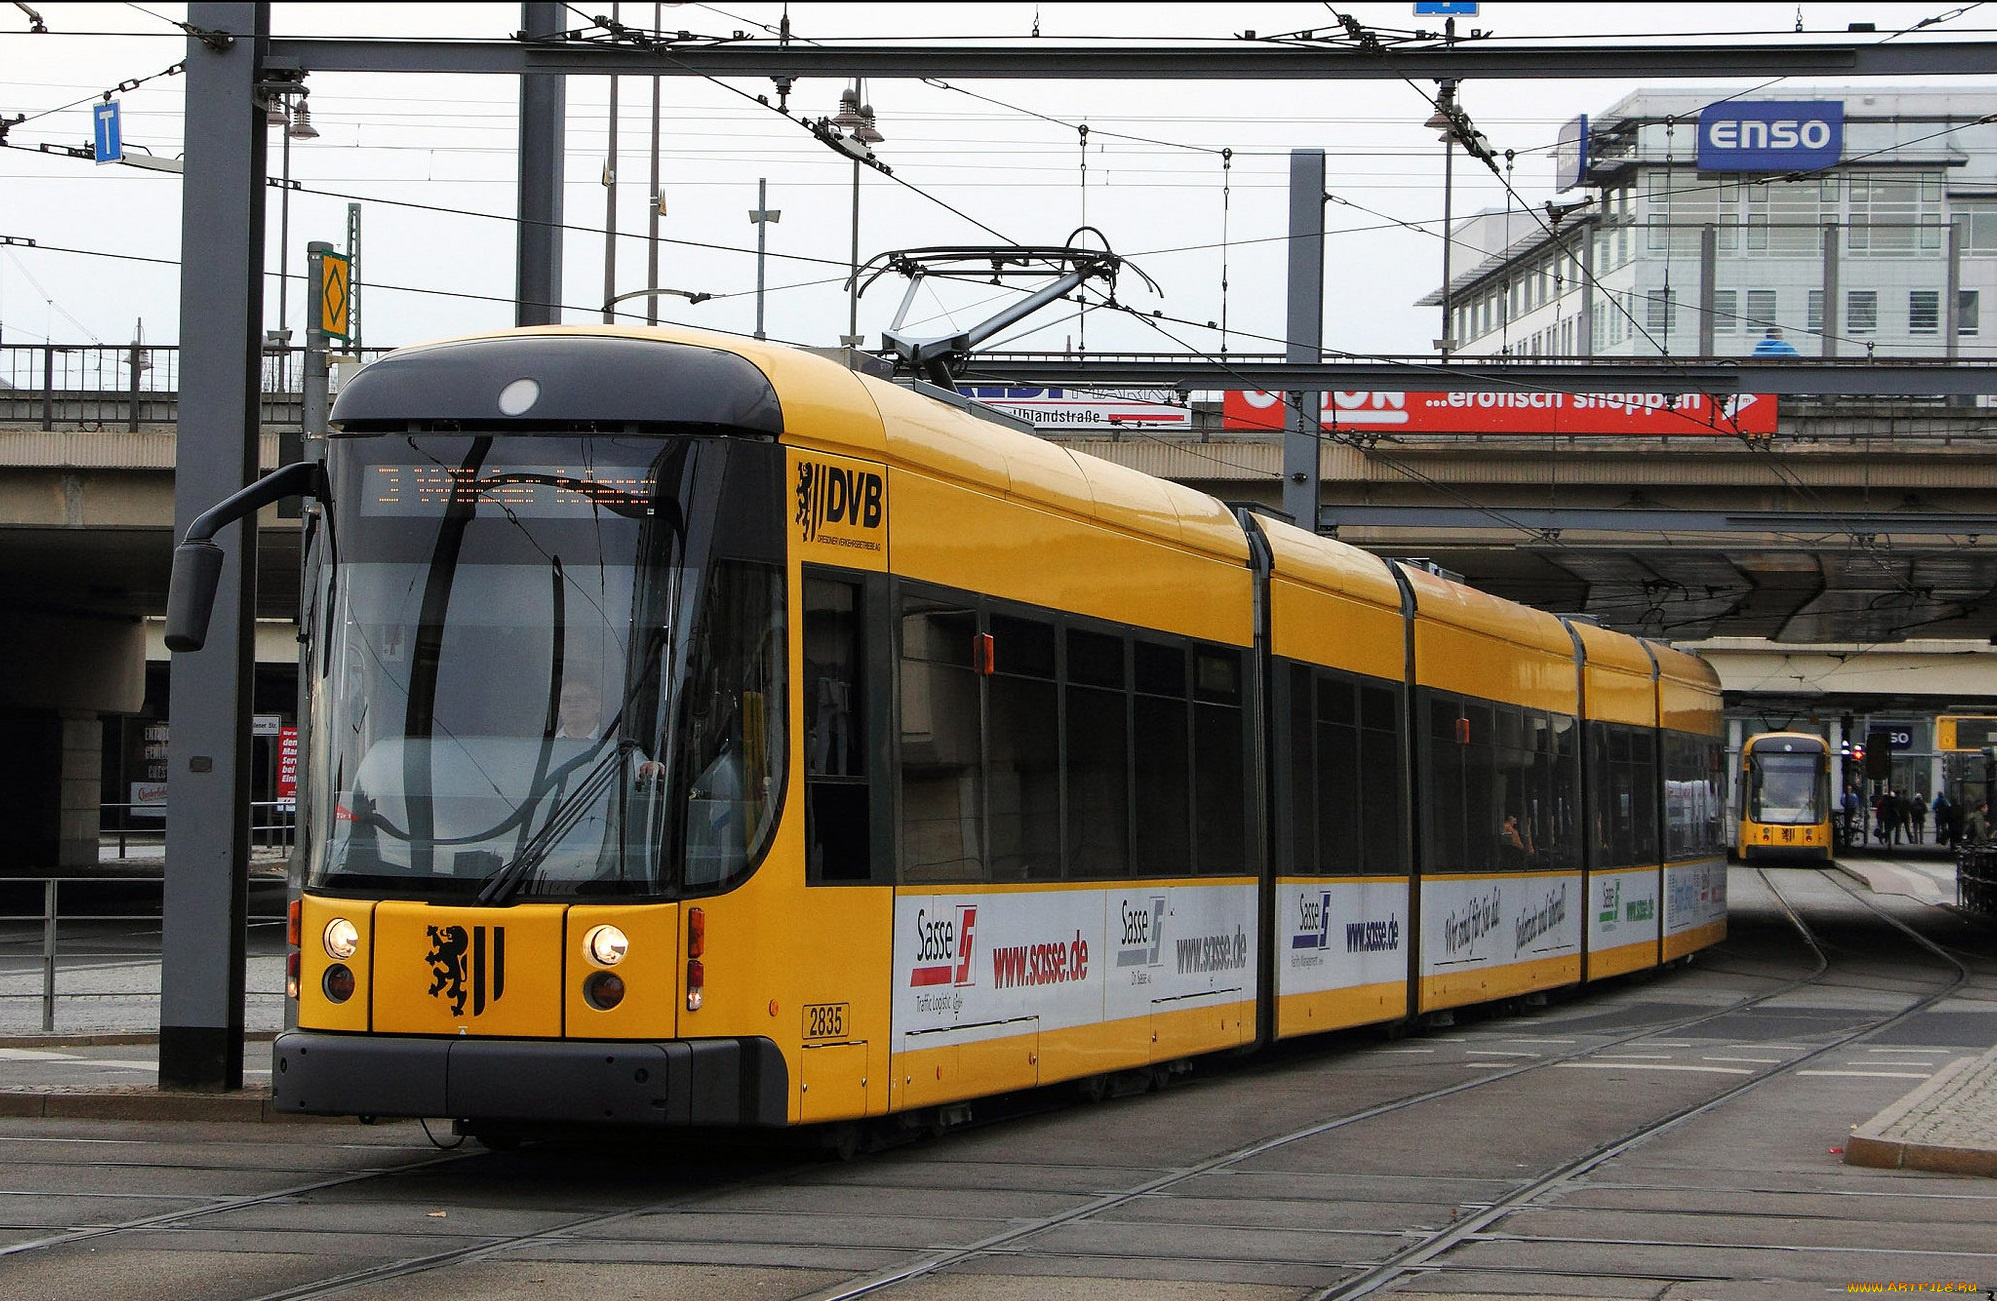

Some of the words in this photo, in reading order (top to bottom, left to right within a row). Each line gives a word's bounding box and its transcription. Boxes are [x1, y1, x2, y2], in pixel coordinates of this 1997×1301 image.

[826, 466, 883, 529] DVB
[1889, 732, 1910, 744] SO
[917, 908, 953, 962] Sasse
[1121, 899, 1148, 945] Sasse
[1299, 893, 1319, 931] Sasse
[1346, 912, 1399, 953] www.sasse.de
[992, 929, 1088, 990] www.sasse.de
[1176, 924, 1247, 975] www.sasse.de
[809, 1006, 842, 1036] 2835
